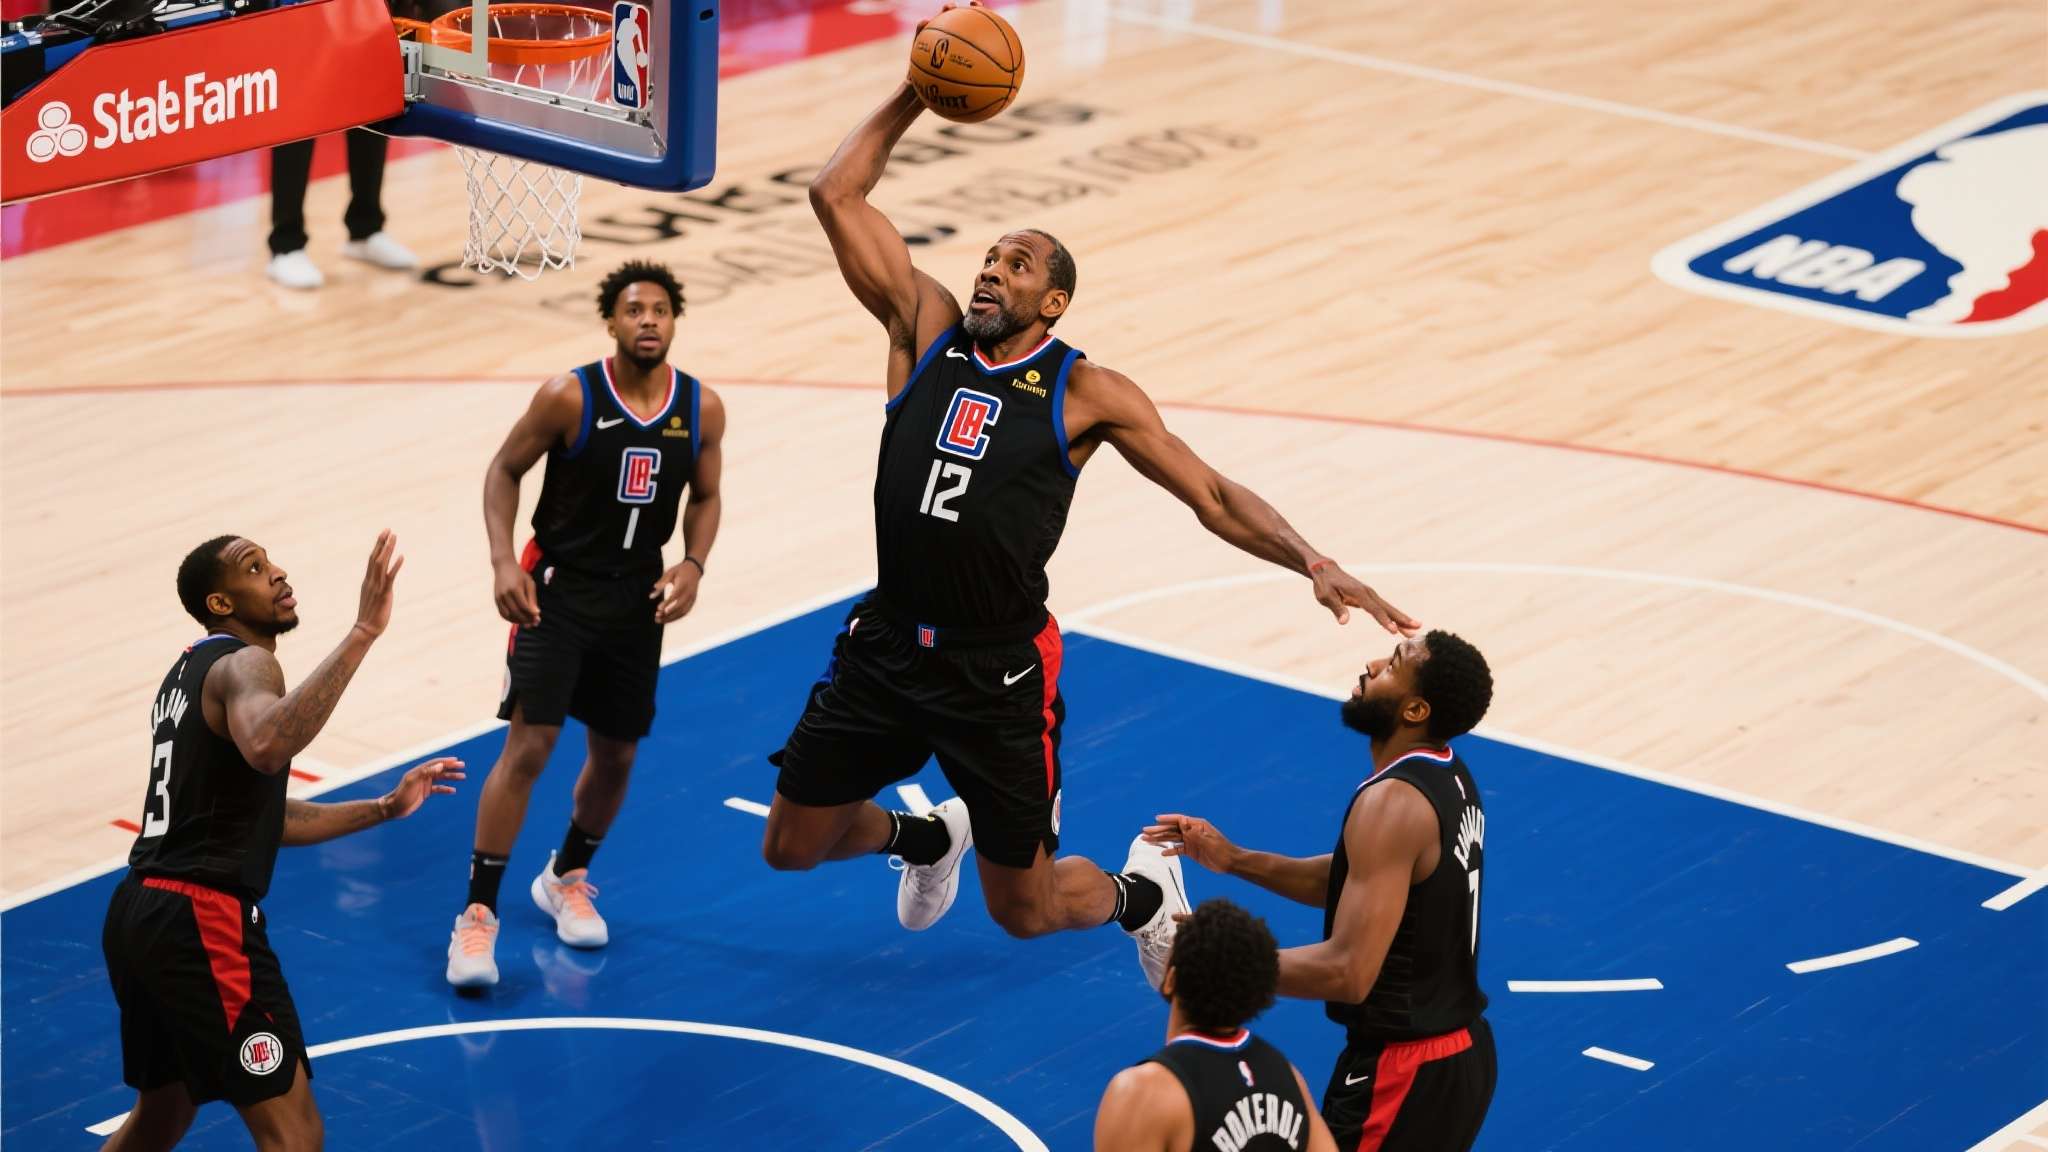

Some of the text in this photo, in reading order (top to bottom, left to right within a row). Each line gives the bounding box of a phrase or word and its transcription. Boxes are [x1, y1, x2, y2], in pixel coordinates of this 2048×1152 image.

[1723, 234, 1927, 302] NBA
[919, 459, 973, 523] 12
[143, 740, 173, 838] 3
